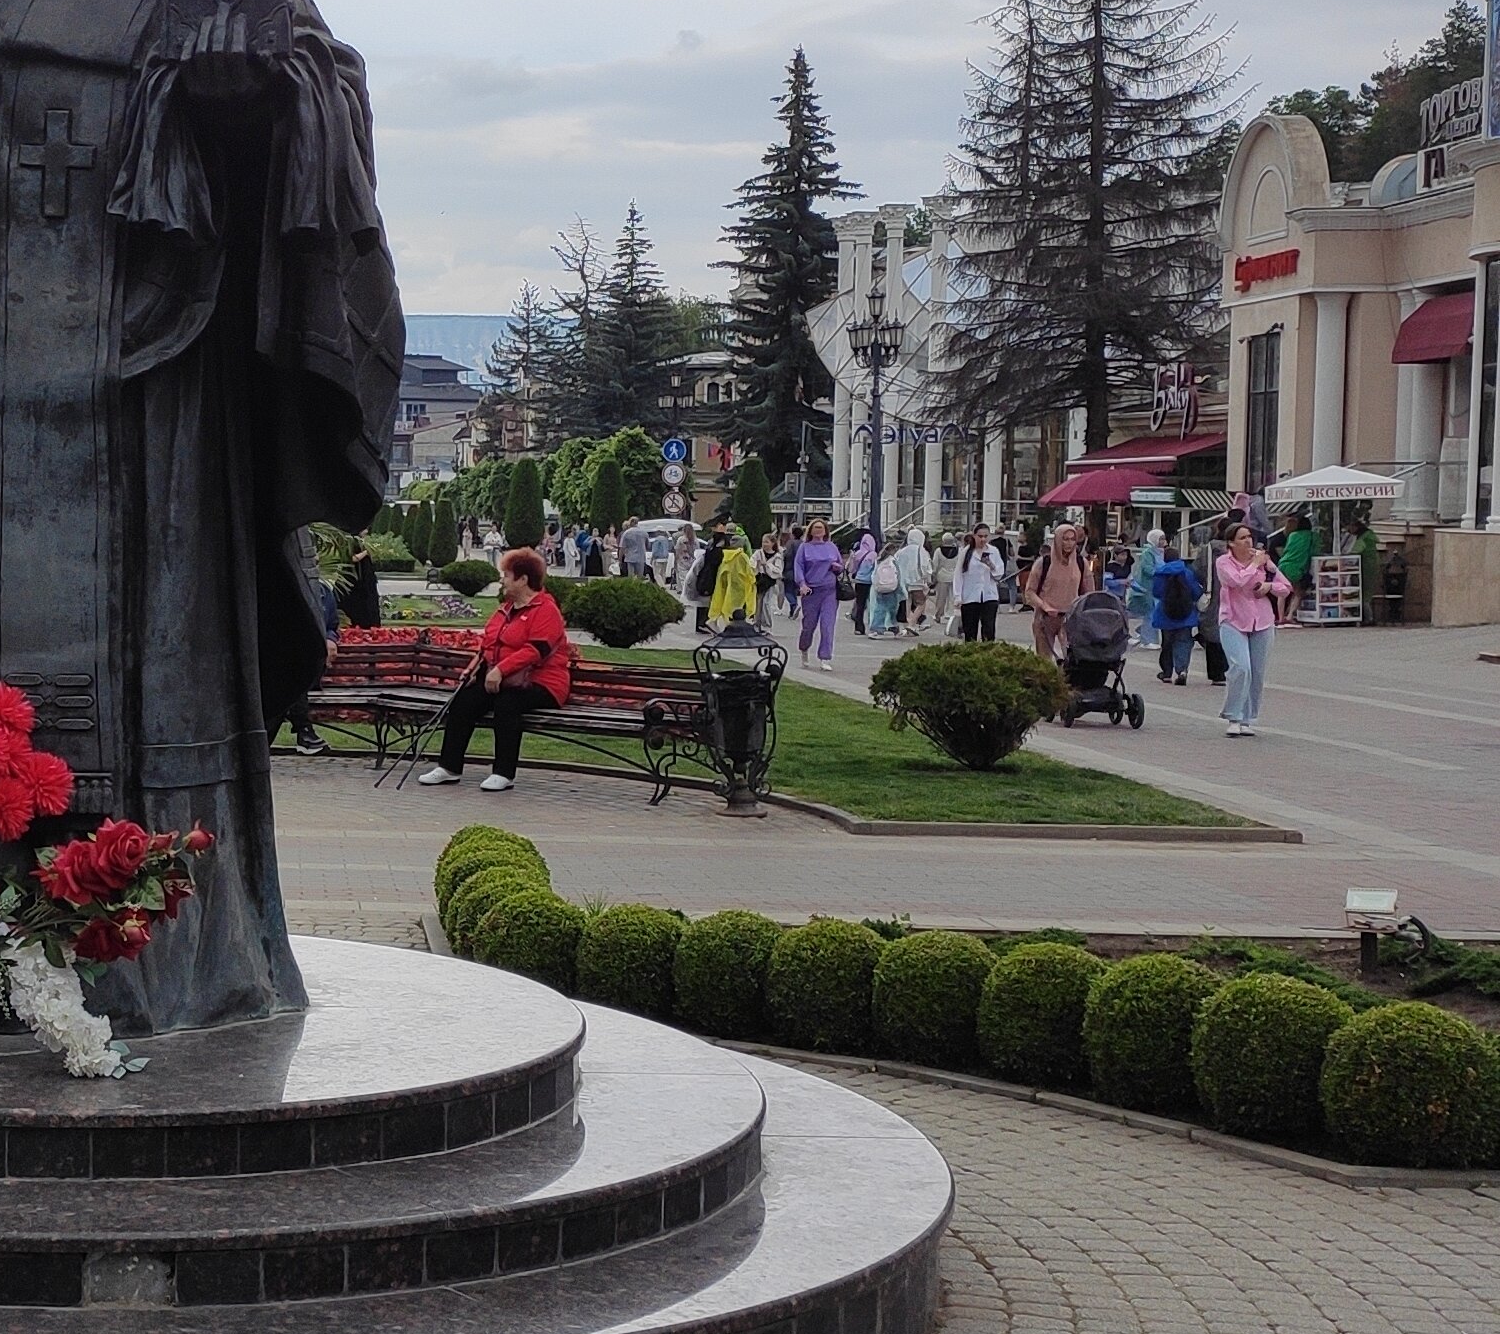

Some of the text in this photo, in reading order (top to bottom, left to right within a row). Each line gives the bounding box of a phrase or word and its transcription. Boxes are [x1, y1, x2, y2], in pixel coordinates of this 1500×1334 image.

[1420, 77, 1482, 146] ТОРГОВ
[1445, 112, 1479, 140] ЦЕНТР
[1422, 147, 1446, 188] ГА
[1305, 485, 1396, 499] ЭКСКУРСИИ
